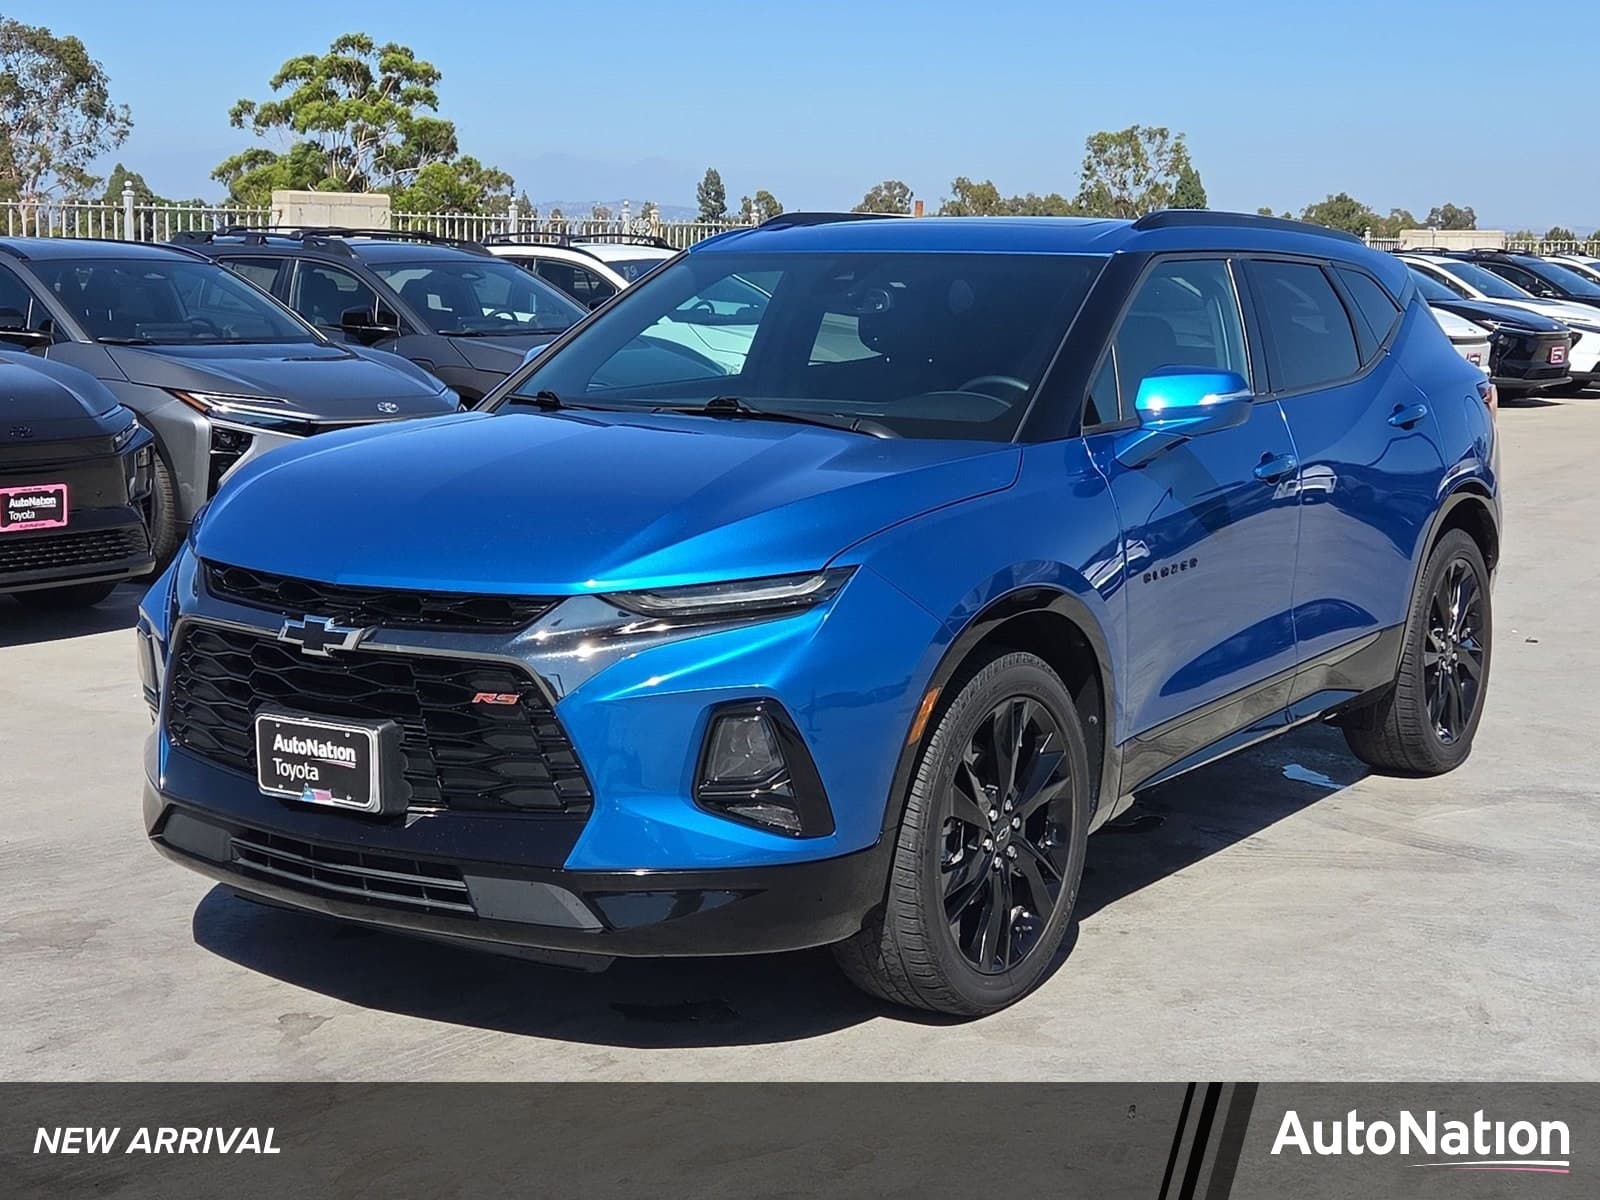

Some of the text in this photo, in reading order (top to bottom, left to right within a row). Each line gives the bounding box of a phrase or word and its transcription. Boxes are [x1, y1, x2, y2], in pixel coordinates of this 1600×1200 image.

[9, 496, 56, 508] AutoNation
[8, 510, 36, 522] Toyota
[471, 692, 520, 705] RS
[273, 734, 357, 762] AutoNation
[272, 757, 319, 782] Toyota
